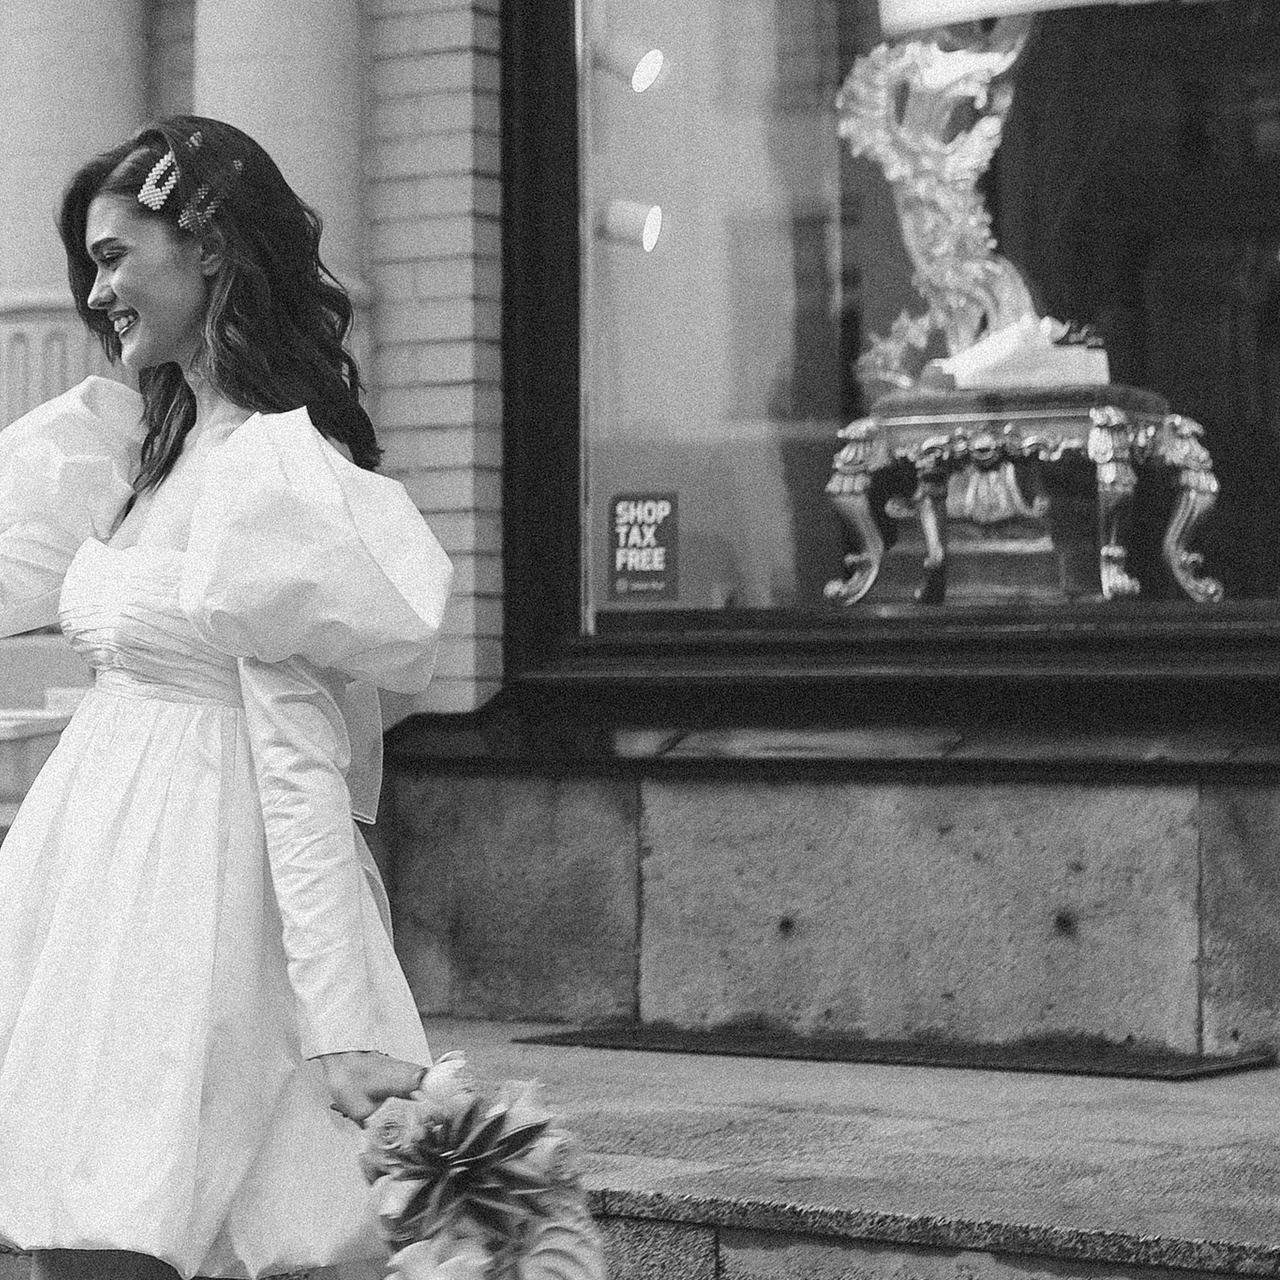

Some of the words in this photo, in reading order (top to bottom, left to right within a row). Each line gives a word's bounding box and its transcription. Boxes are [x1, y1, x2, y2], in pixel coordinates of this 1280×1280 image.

[614, 499, 672, 524] SHOP
[614, 523, 658, 548] TAX
[614, 547, 666, 572] FREE
